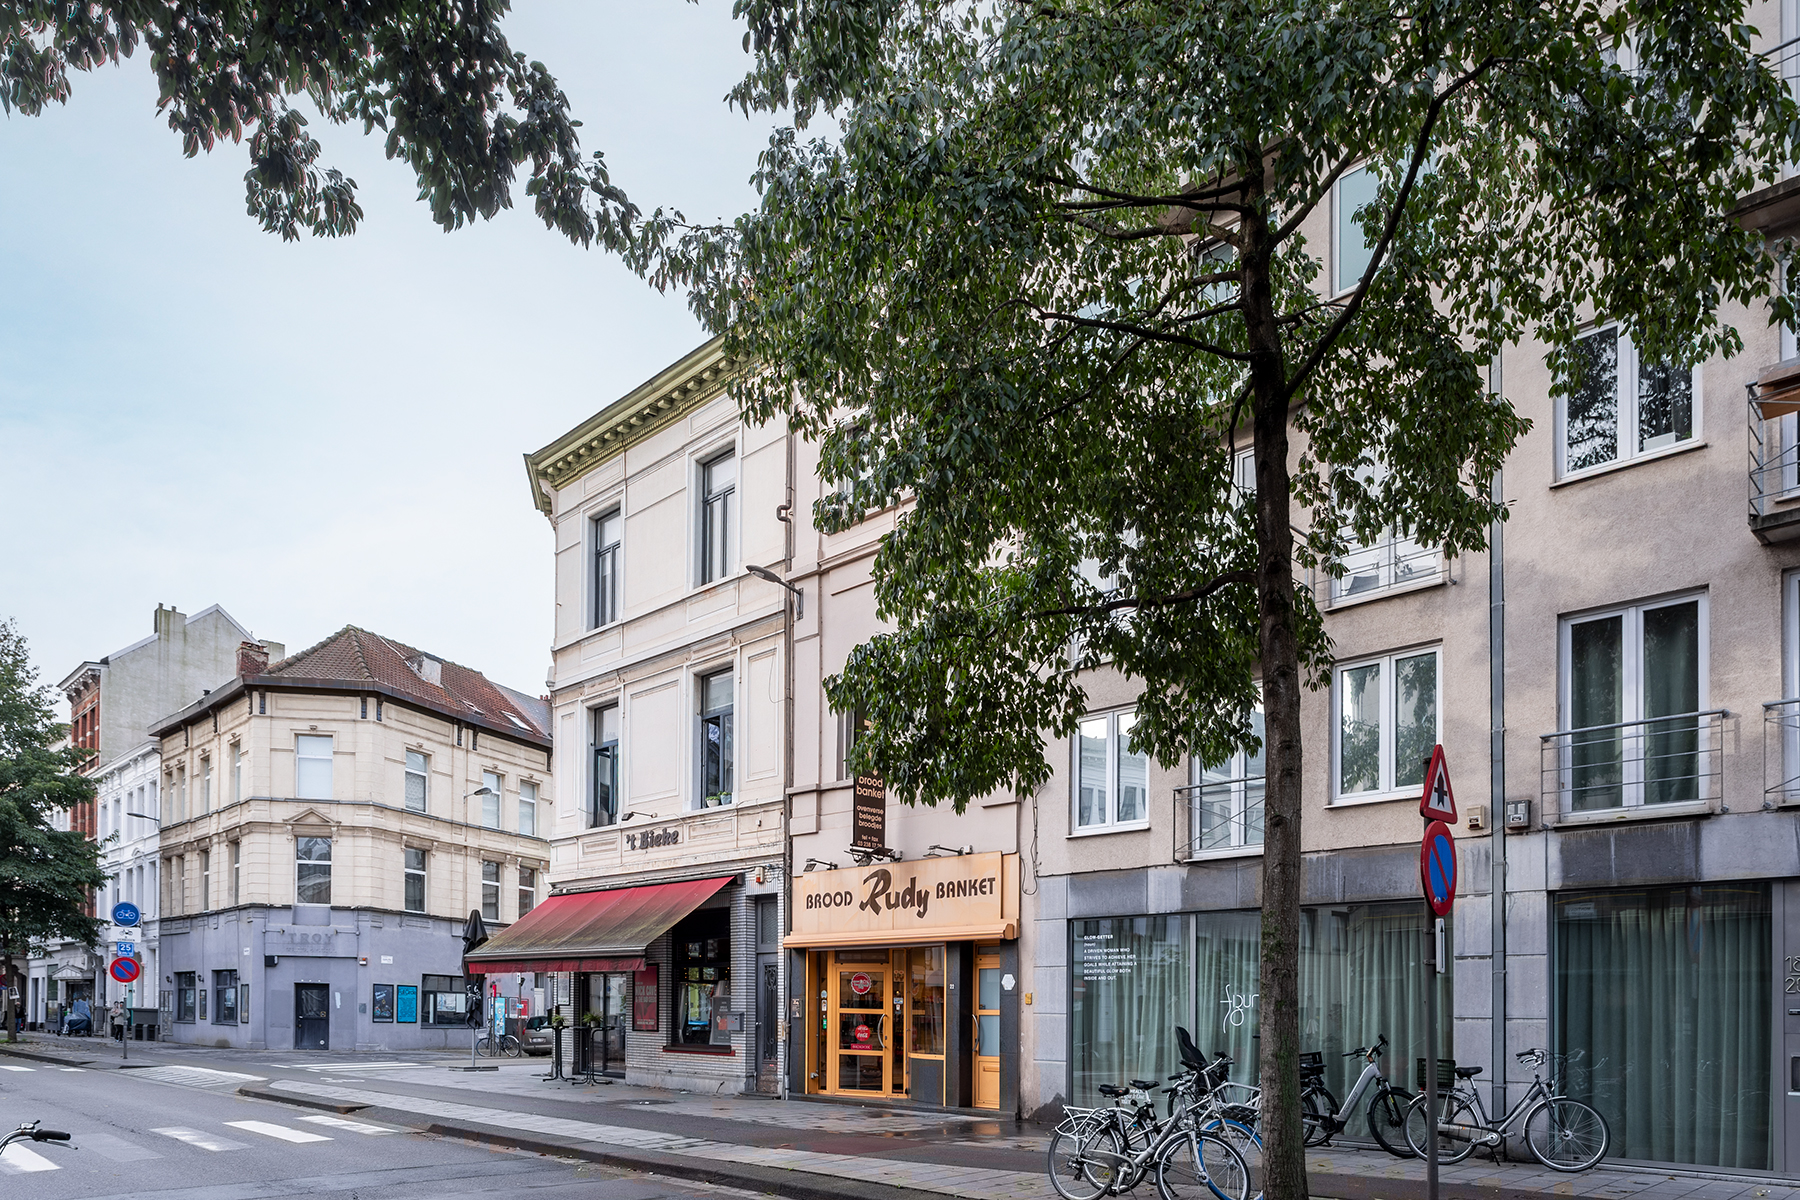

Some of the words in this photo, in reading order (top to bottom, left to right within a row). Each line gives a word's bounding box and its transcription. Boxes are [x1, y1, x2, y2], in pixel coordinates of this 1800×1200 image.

[858, 776, 884, 788] brood
[856, 784, 884, 799] banket
[856, 804, 884, 815] ovenverse
[858, 812, 882, 822] belegde
[858, 820, 882, 830] broodjes
[639, 828, 679, 849] Bieke
[806, 890, 853, 910] BROOD
[859, 868, 930, 919] Rudy
[936, 877, 996, 899] BANKET
